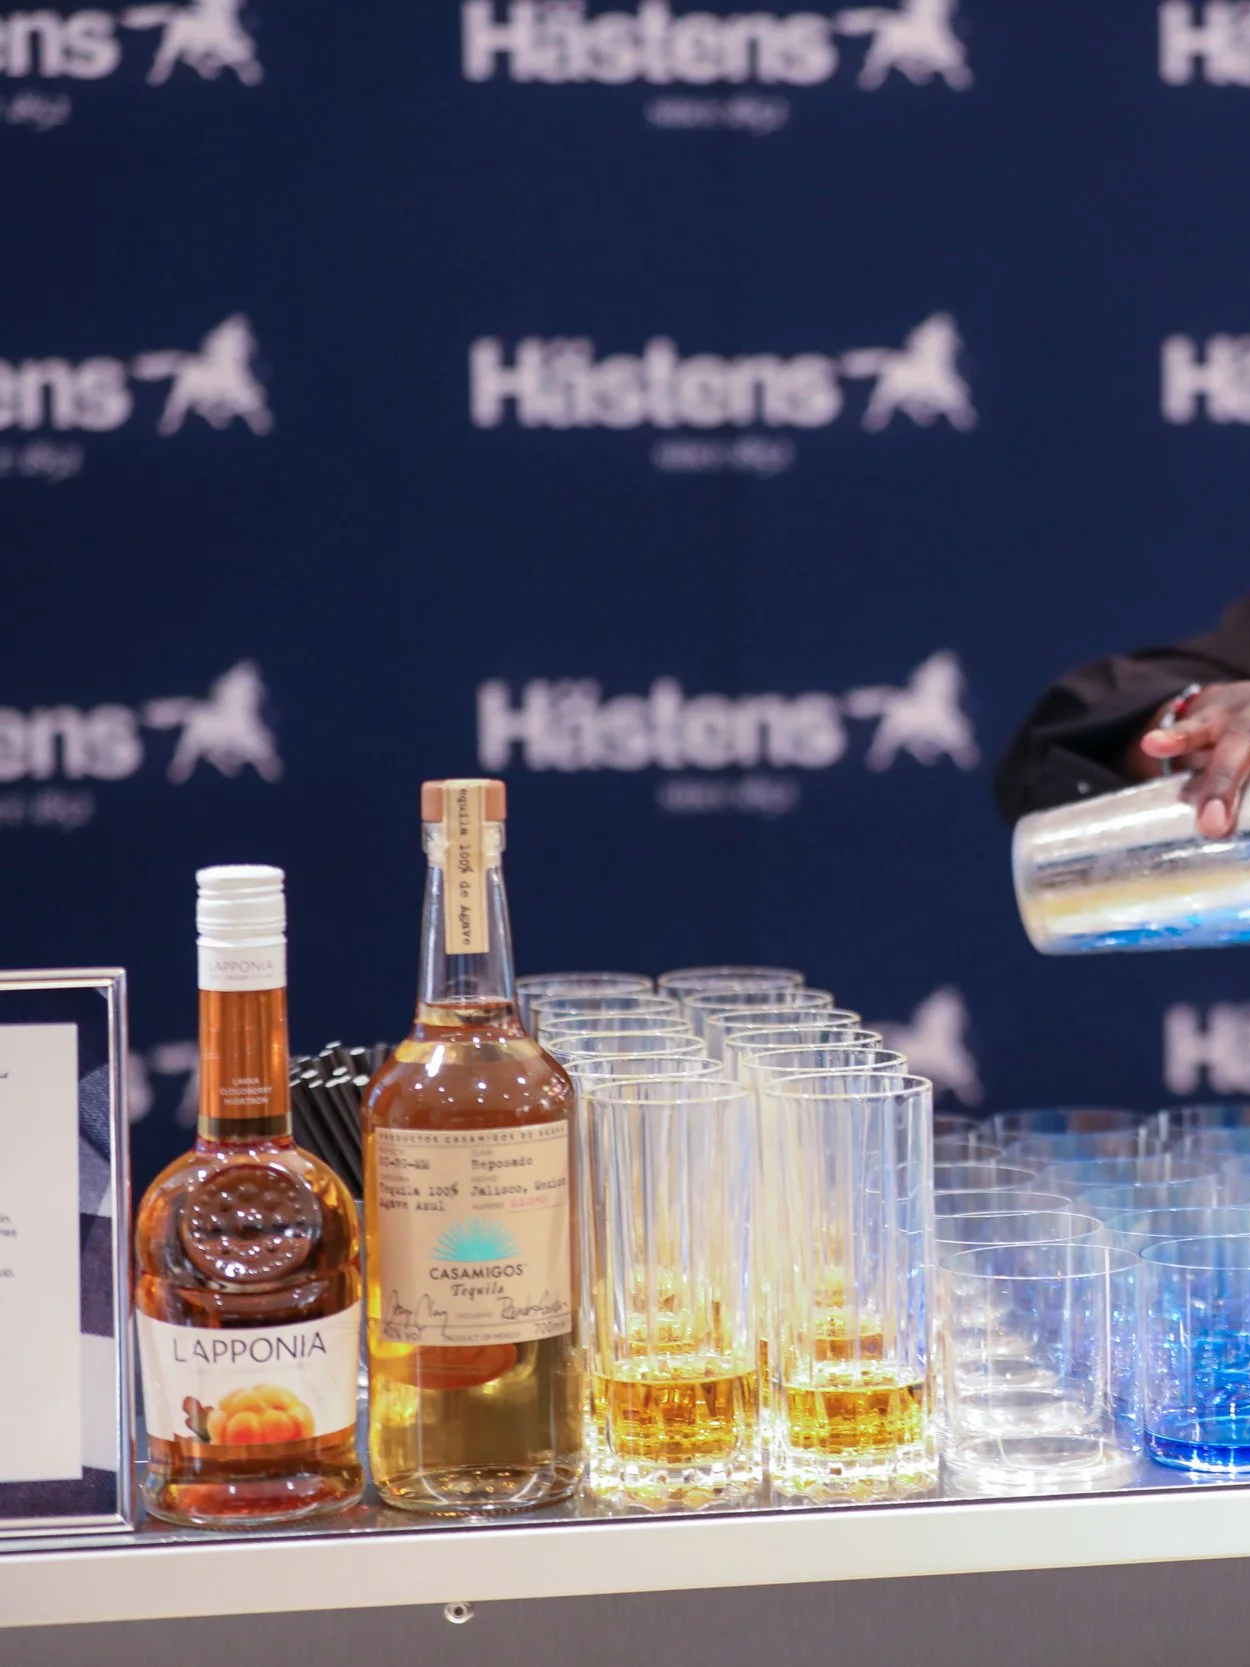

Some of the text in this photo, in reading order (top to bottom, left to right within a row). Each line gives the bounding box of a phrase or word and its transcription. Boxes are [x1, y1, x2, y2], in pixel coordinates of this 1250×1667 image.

[462, 0, 838, 85] Hästens
[470, 337, 842, 428] Hästens
[478, 678, 846, 771] Hästens
[208, 960, 274, 974] LAPPONIA
[429, 1264, 524, 1281] CASAMIGOS
[450, 1281, 505, 1301] Tequila
[173, 1331, 328, 1363] LAPPONIA
